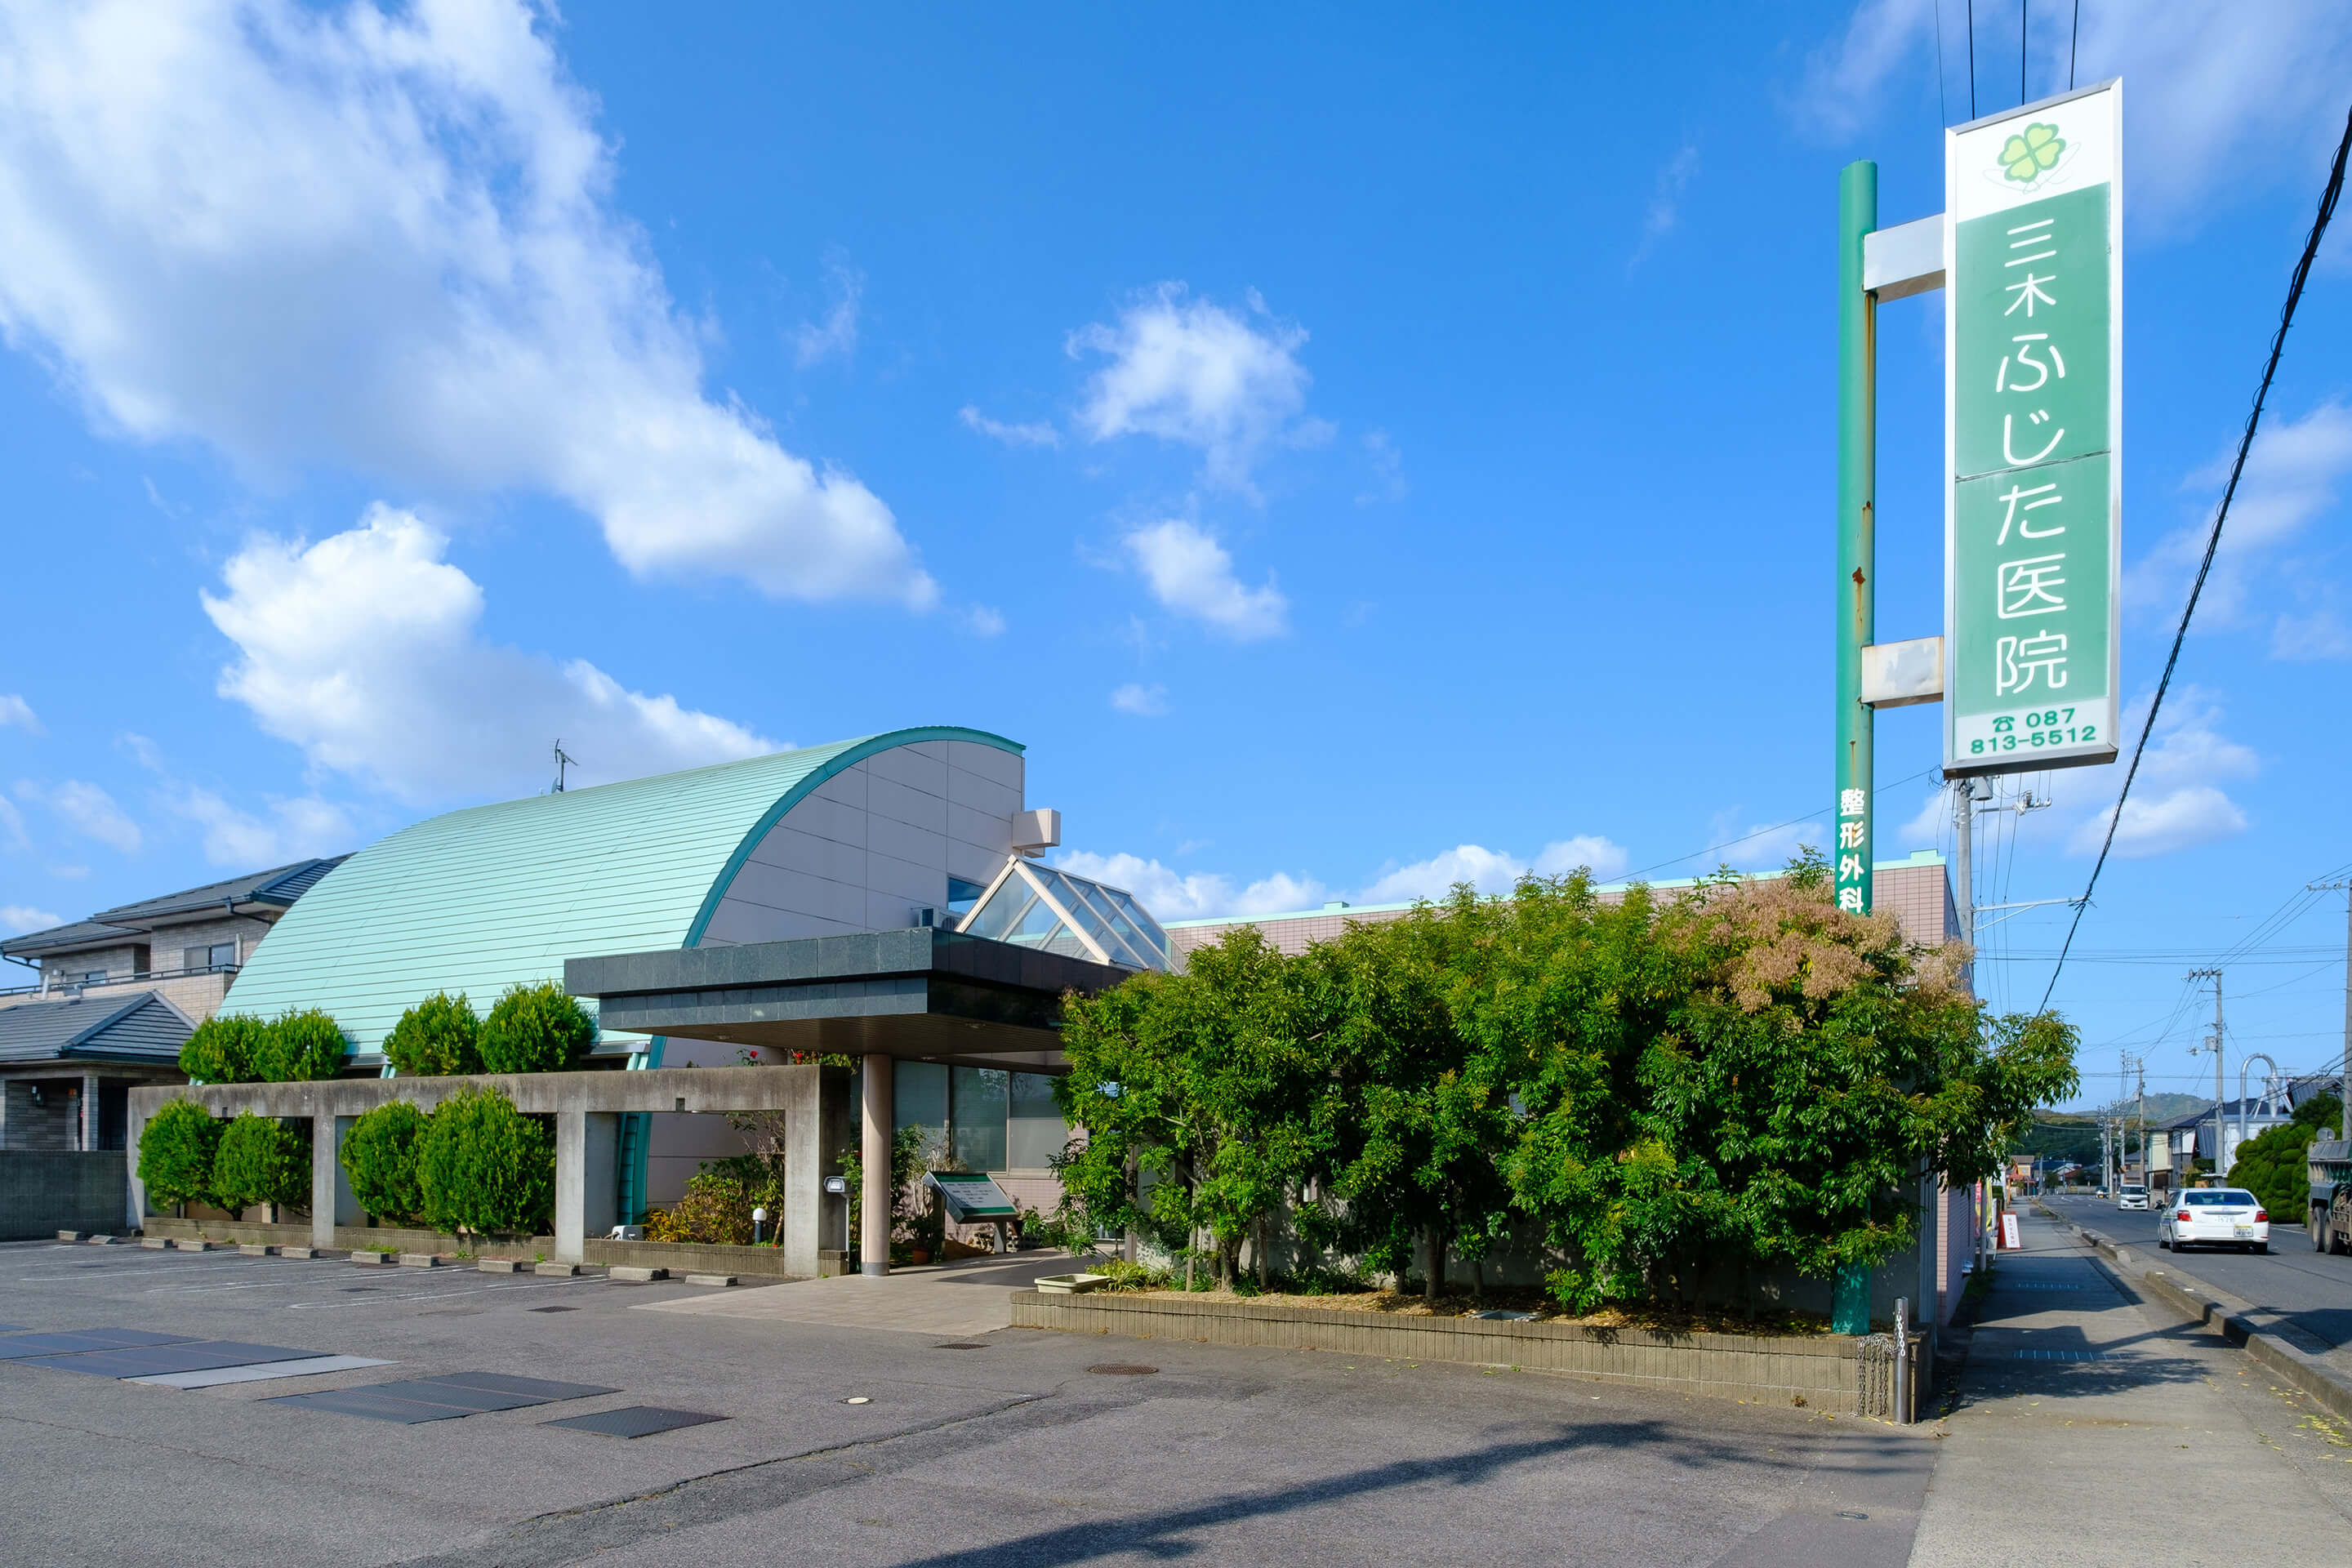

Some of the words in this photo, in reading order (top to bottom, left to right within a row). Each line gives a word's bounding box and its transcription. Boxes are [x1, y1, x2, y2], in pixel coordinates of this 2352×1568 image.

[1996, 219, 2067, 696] 三木ふじた医院
[1971, 726, 2096, 754] 813-5512
[2026, 708, 2075, 727] 087
[1839, 788, 1864, 913] 整形外科
